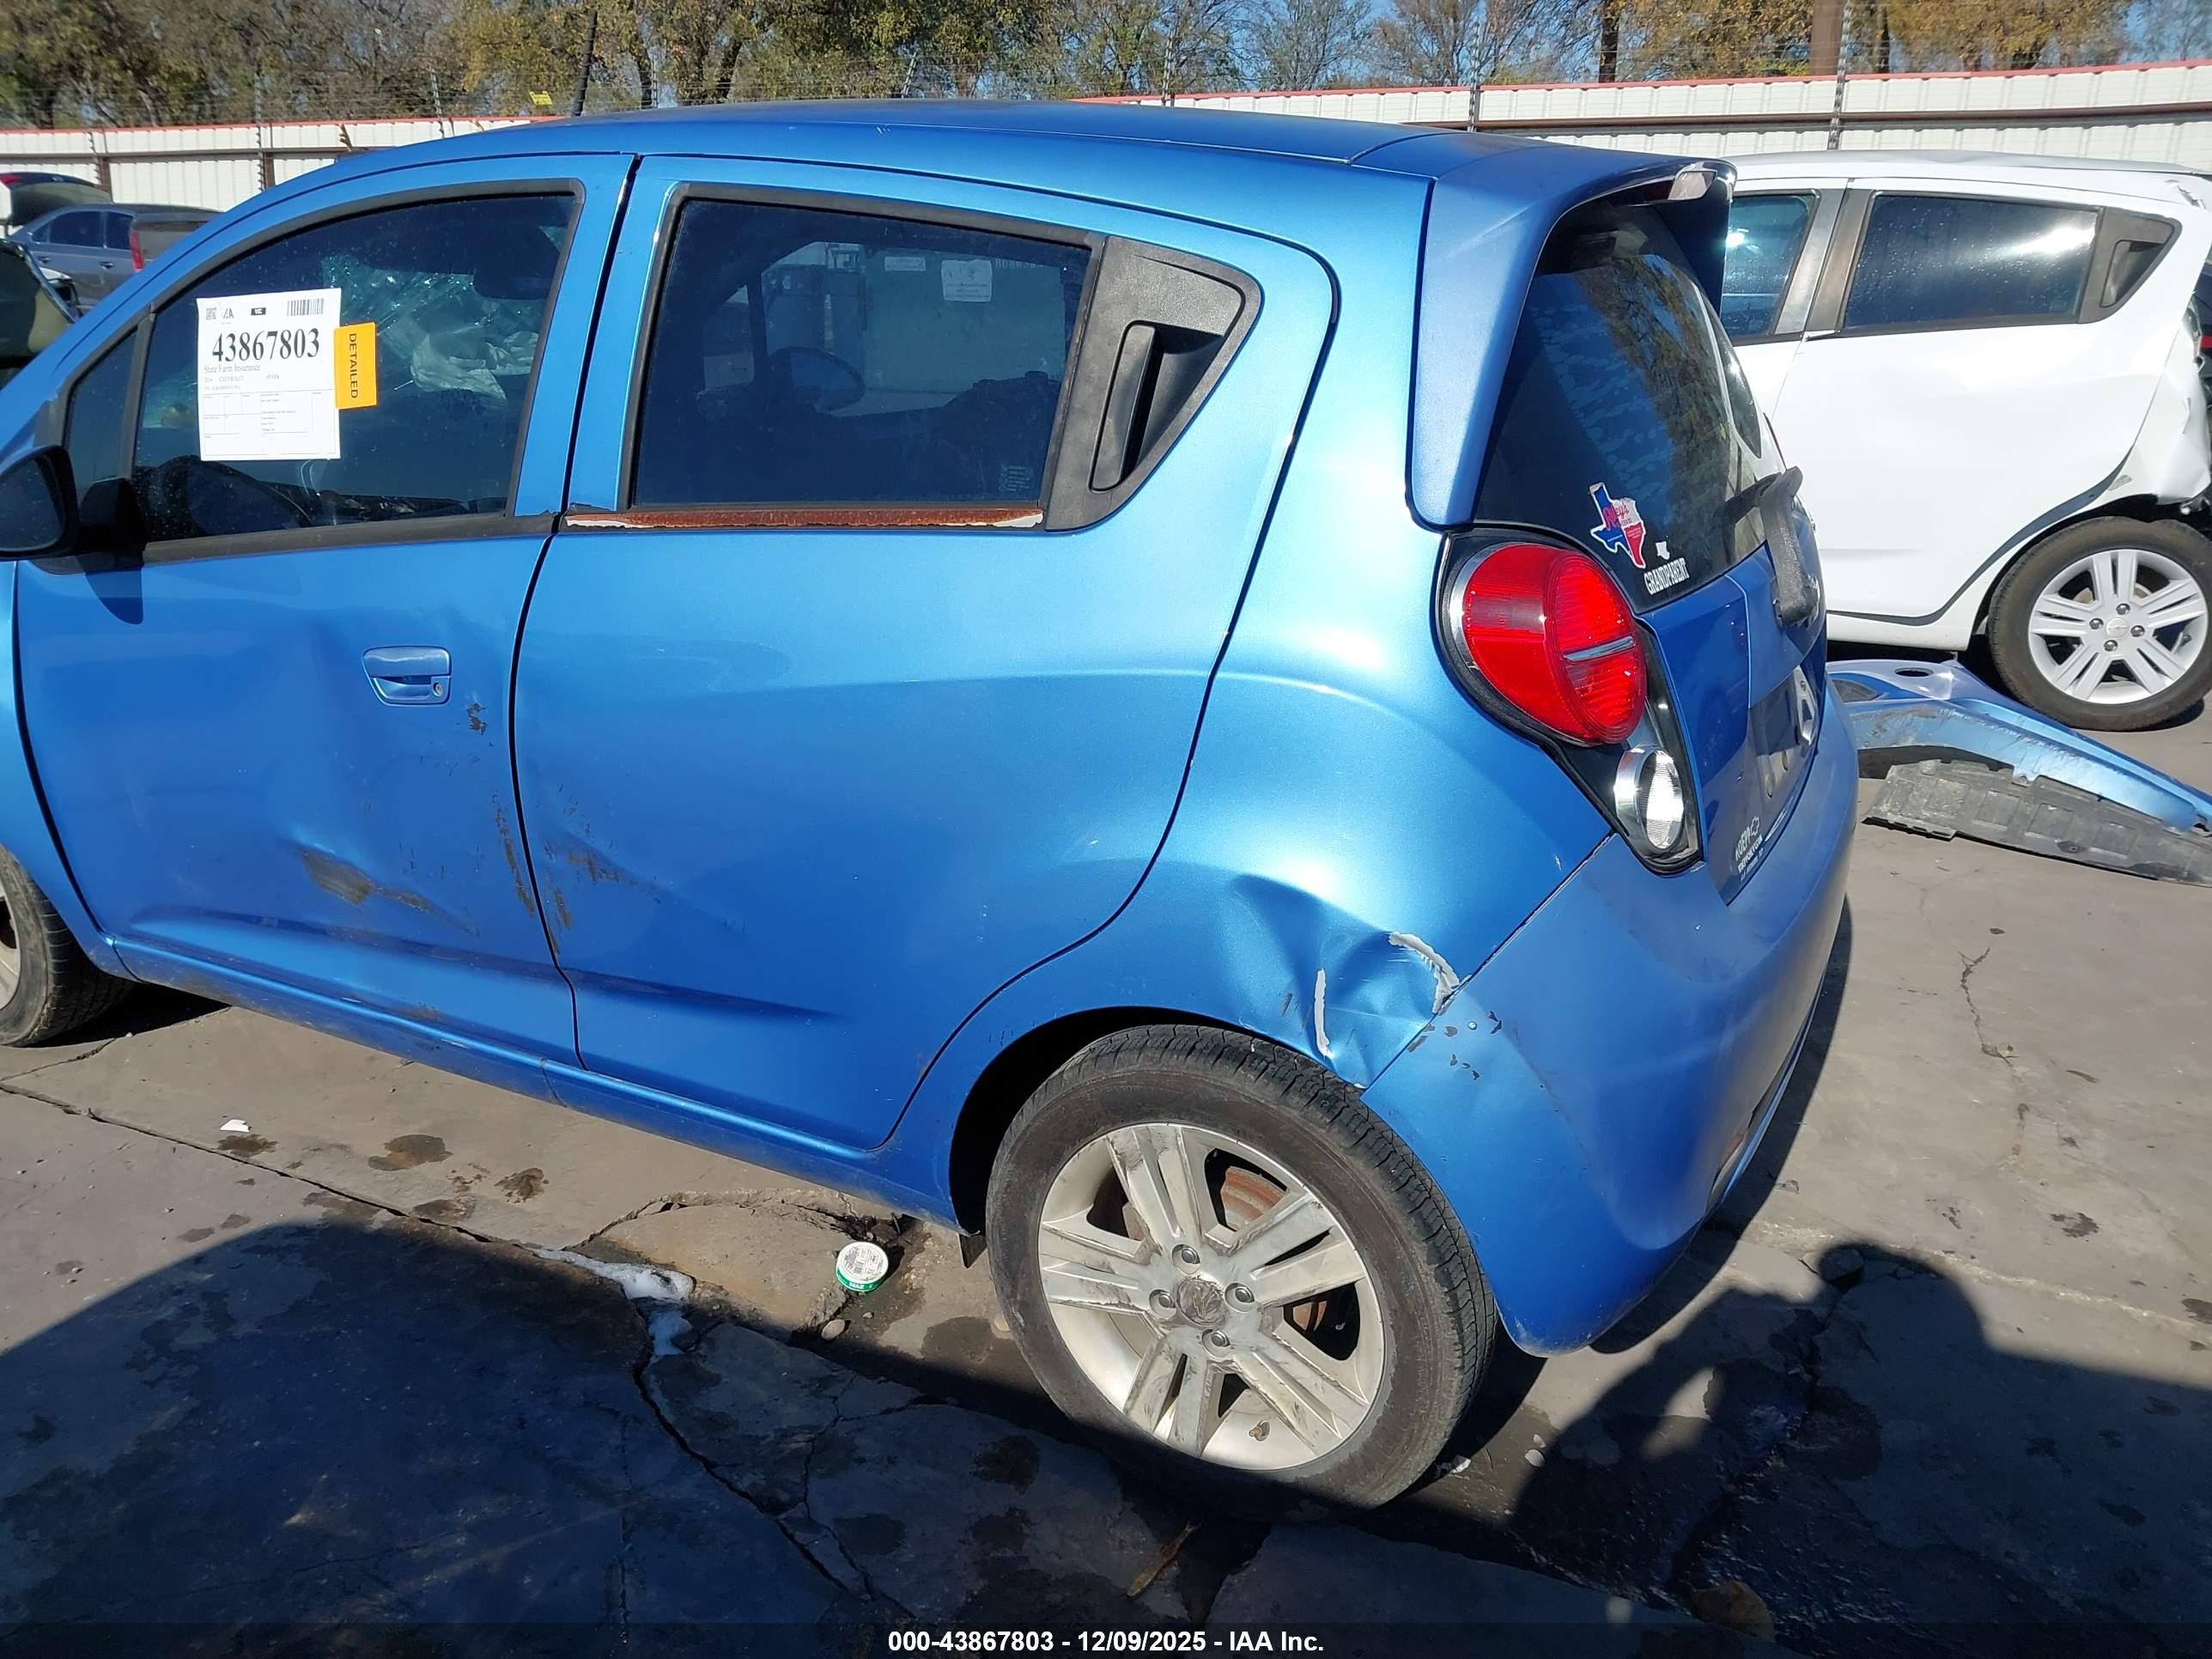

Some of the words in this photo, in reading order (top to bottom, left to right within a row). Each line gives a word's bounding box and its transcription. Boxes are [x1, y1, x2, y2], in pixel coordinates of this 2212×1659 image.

[212, 327, 319, 362] 43867803
[349, 332, 359, 399] DETAILED
[1644, 557, 1690, 595] GRANDPARENT
